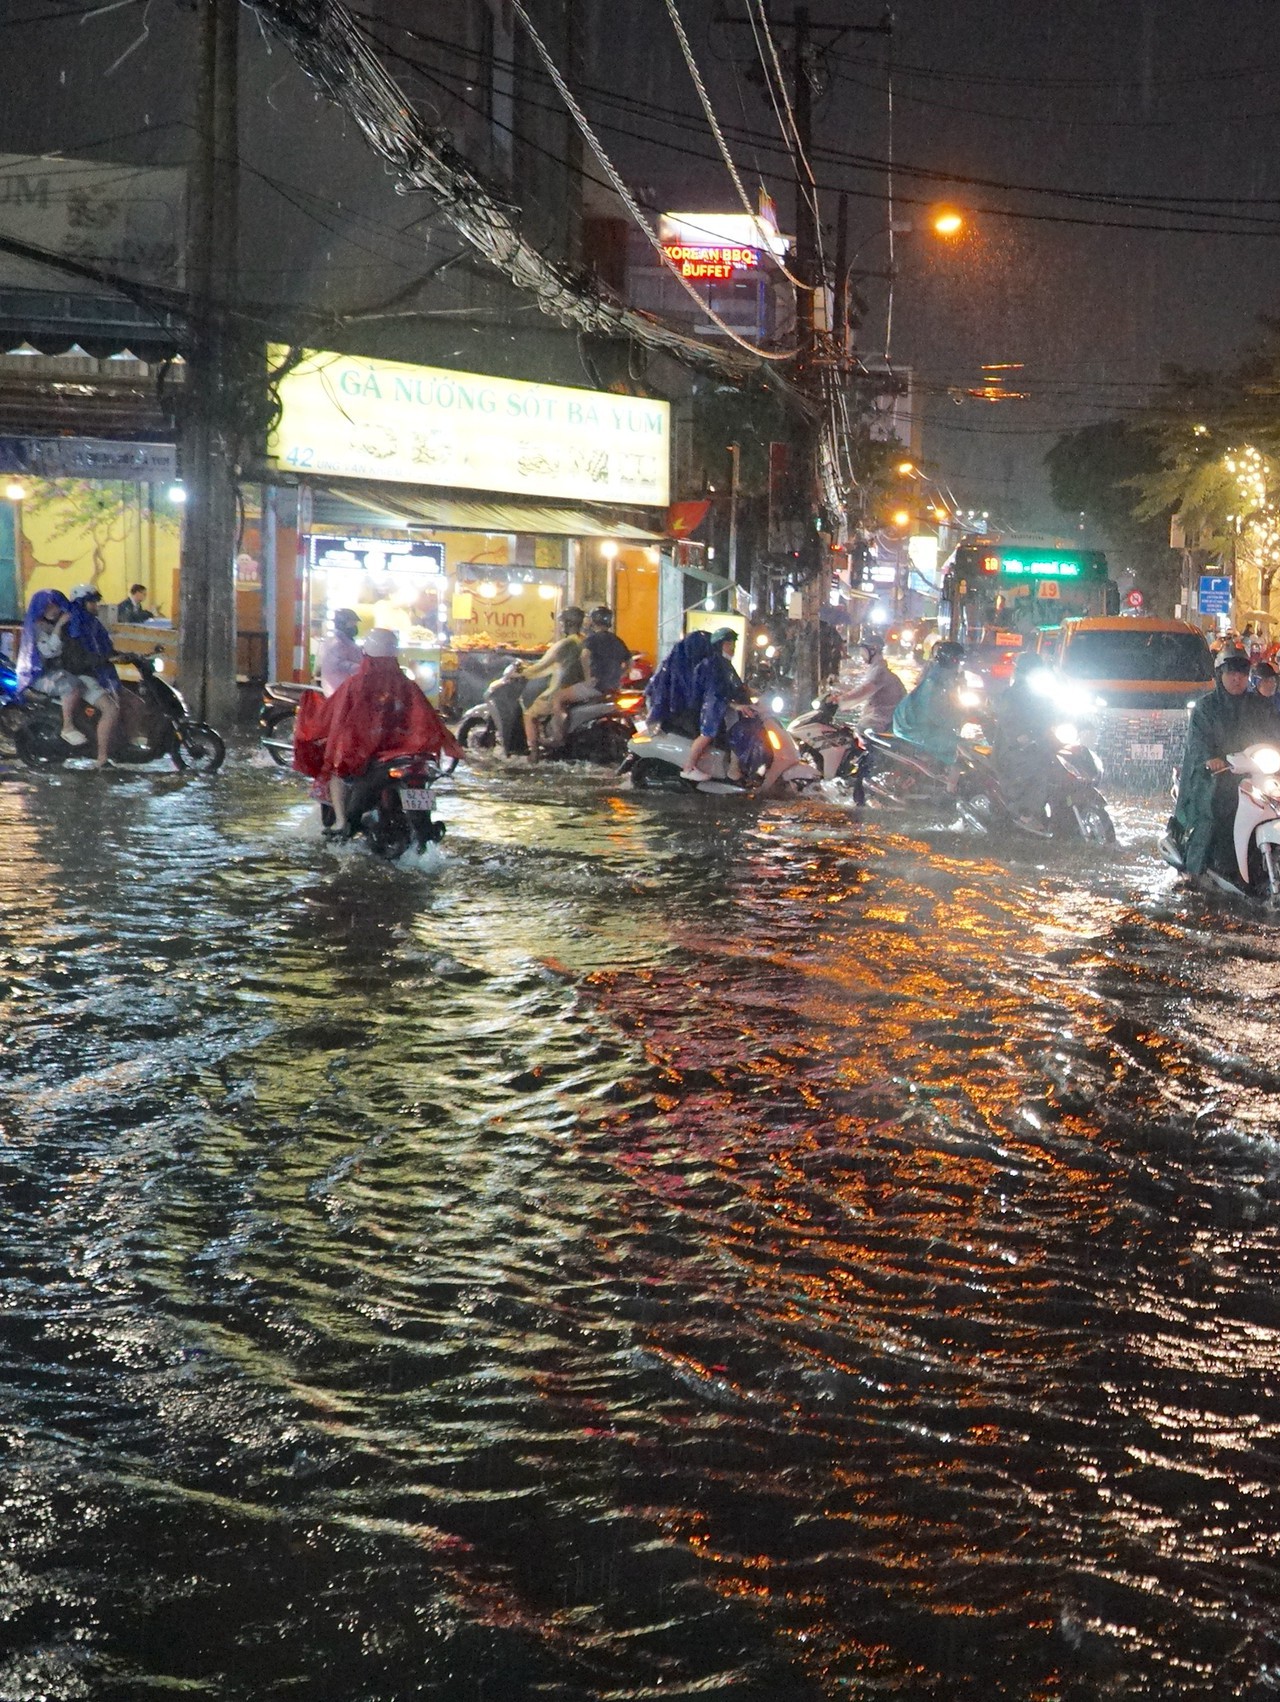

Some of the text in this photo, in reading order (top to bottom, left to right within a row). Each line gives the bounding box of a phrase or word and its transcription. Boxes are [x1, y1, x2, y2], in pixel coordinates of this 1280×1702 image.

[663, 246, 753, 263] KOREAN BBQ
[682, 264, 731, 278] BUFFET
[340, 366, 383, 400] GÀ
[610, 406, 663, 436] YUM
[286, 446, 315, 468] 42
[1040, 582, 1058, 597] 19
